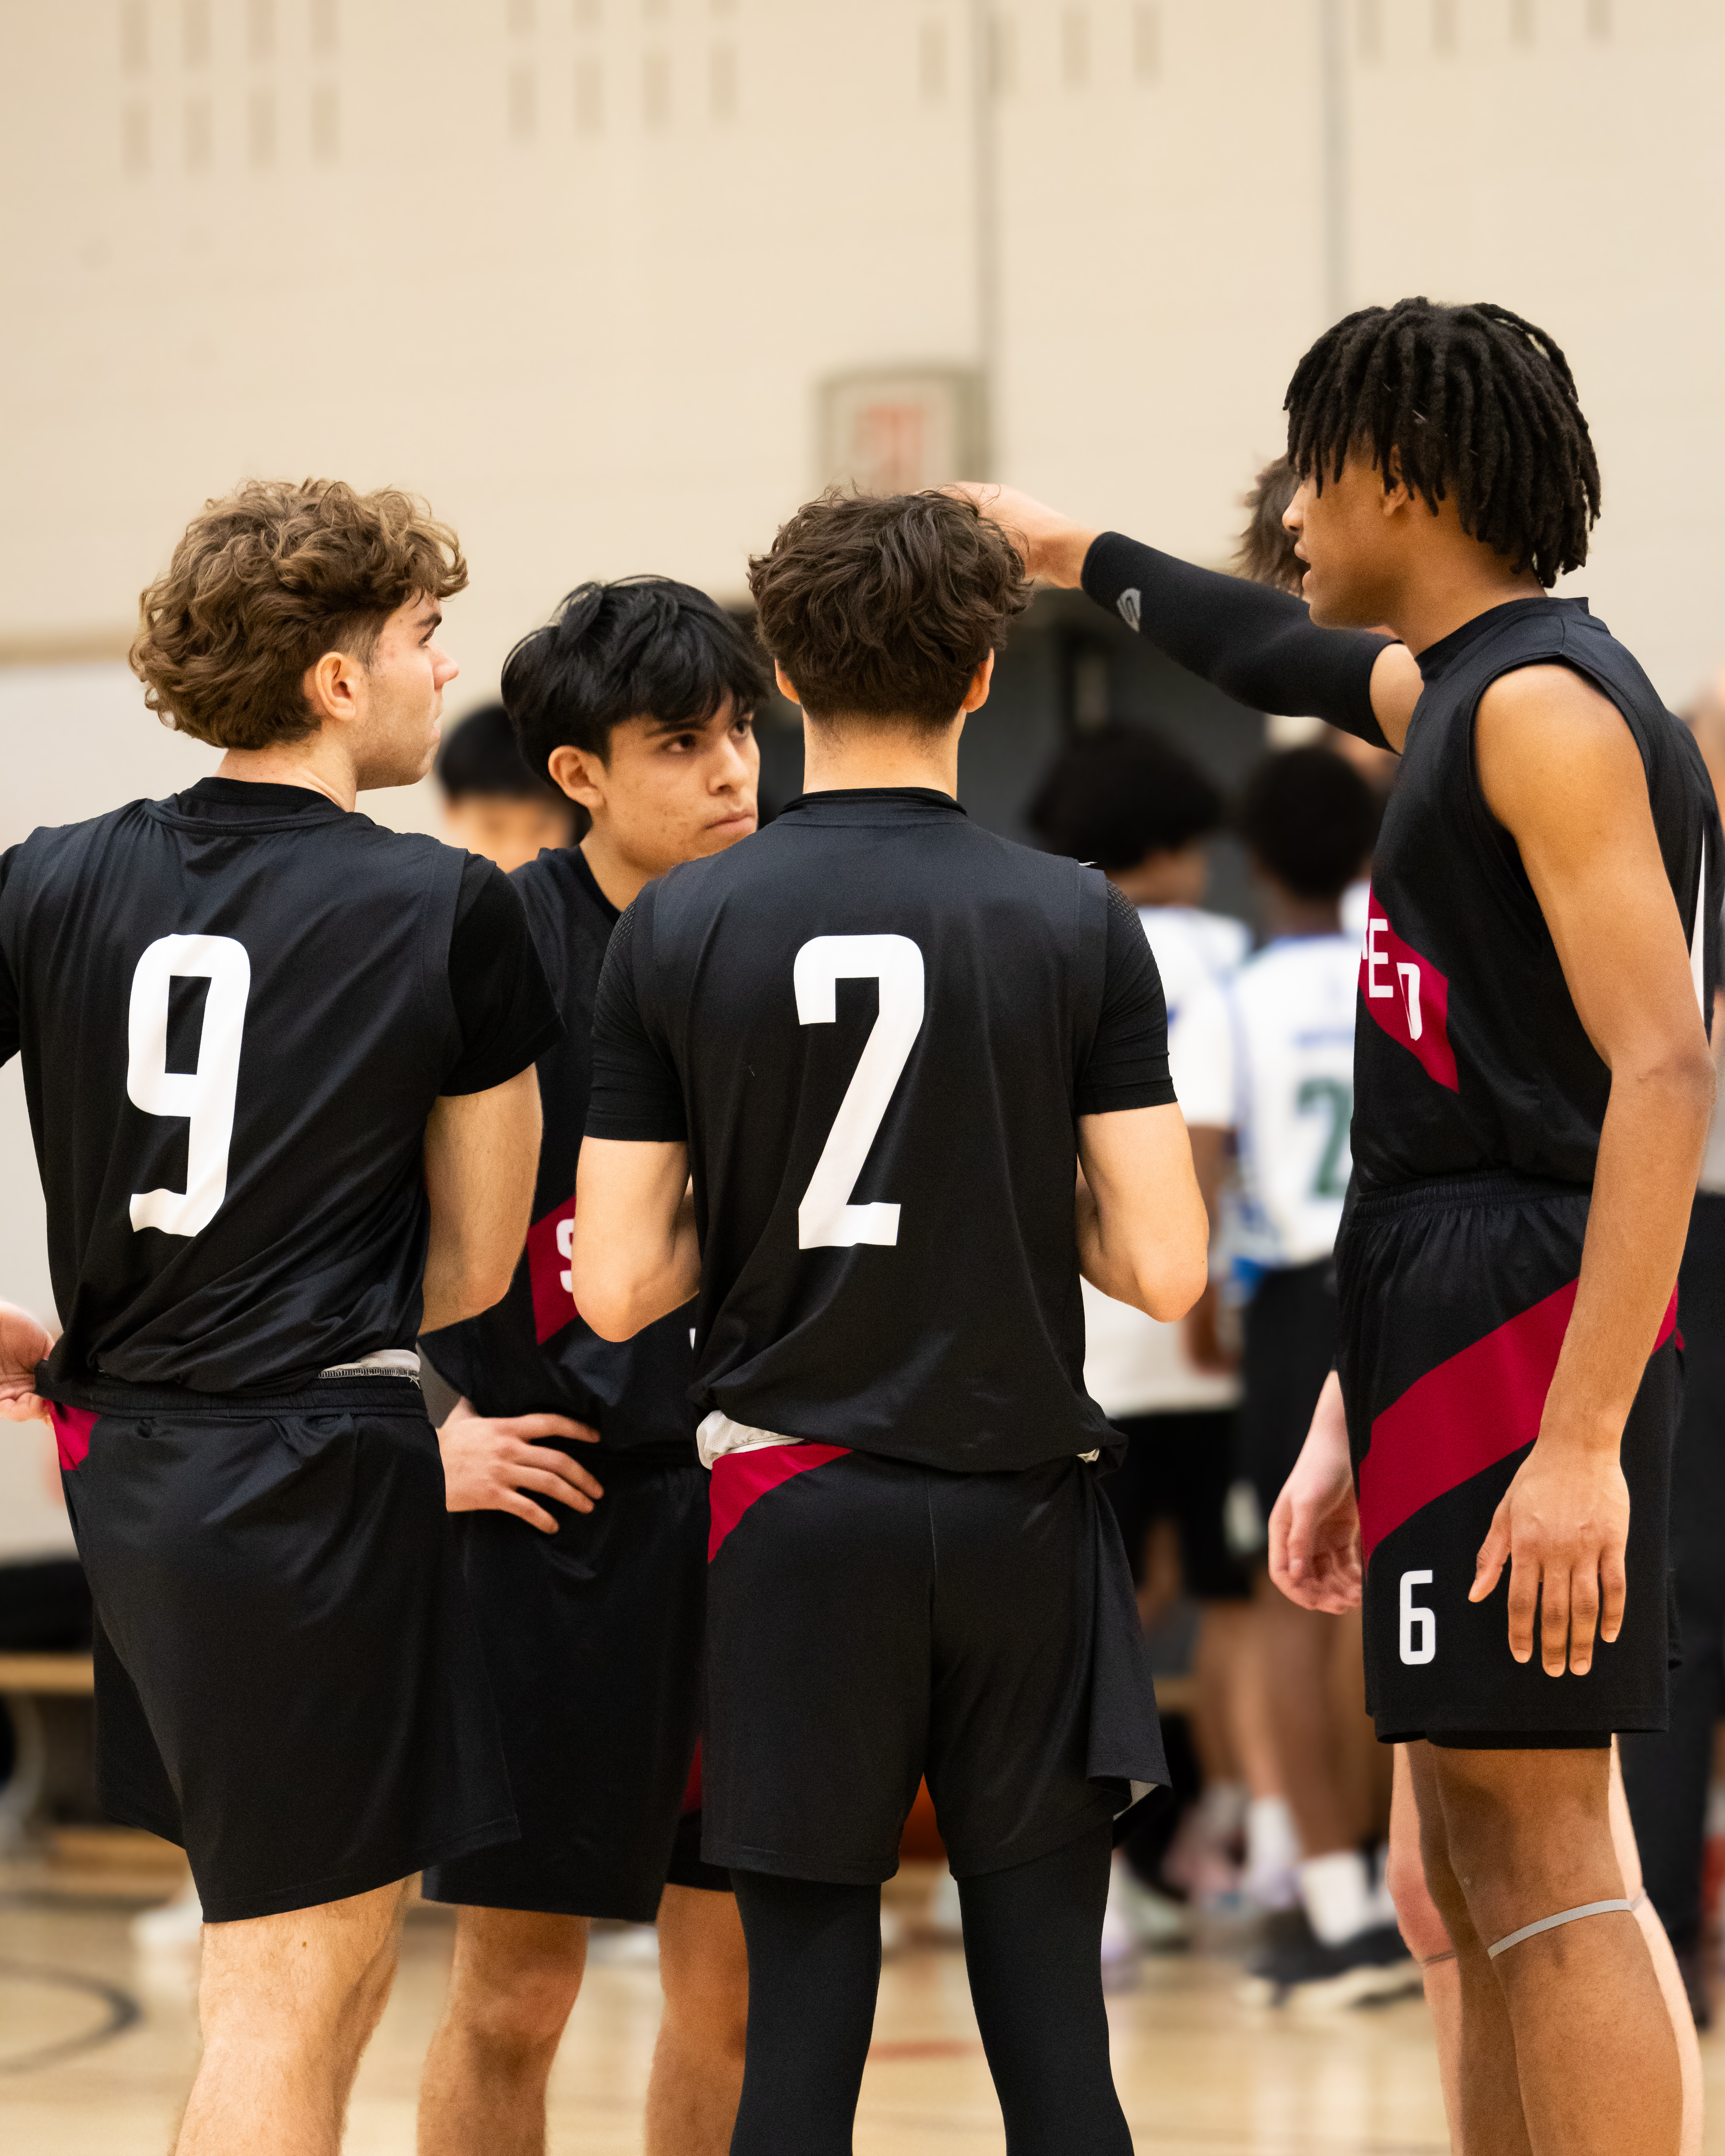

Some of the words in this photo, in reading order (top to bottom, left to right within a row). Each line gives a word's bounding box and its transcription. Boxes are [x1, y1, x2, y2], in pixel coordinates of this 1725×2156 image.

[127, 933, 251, 1237] 9
[793, 934, 925, 1249] 2
[1399, 1569, 1436, 1665] 6
